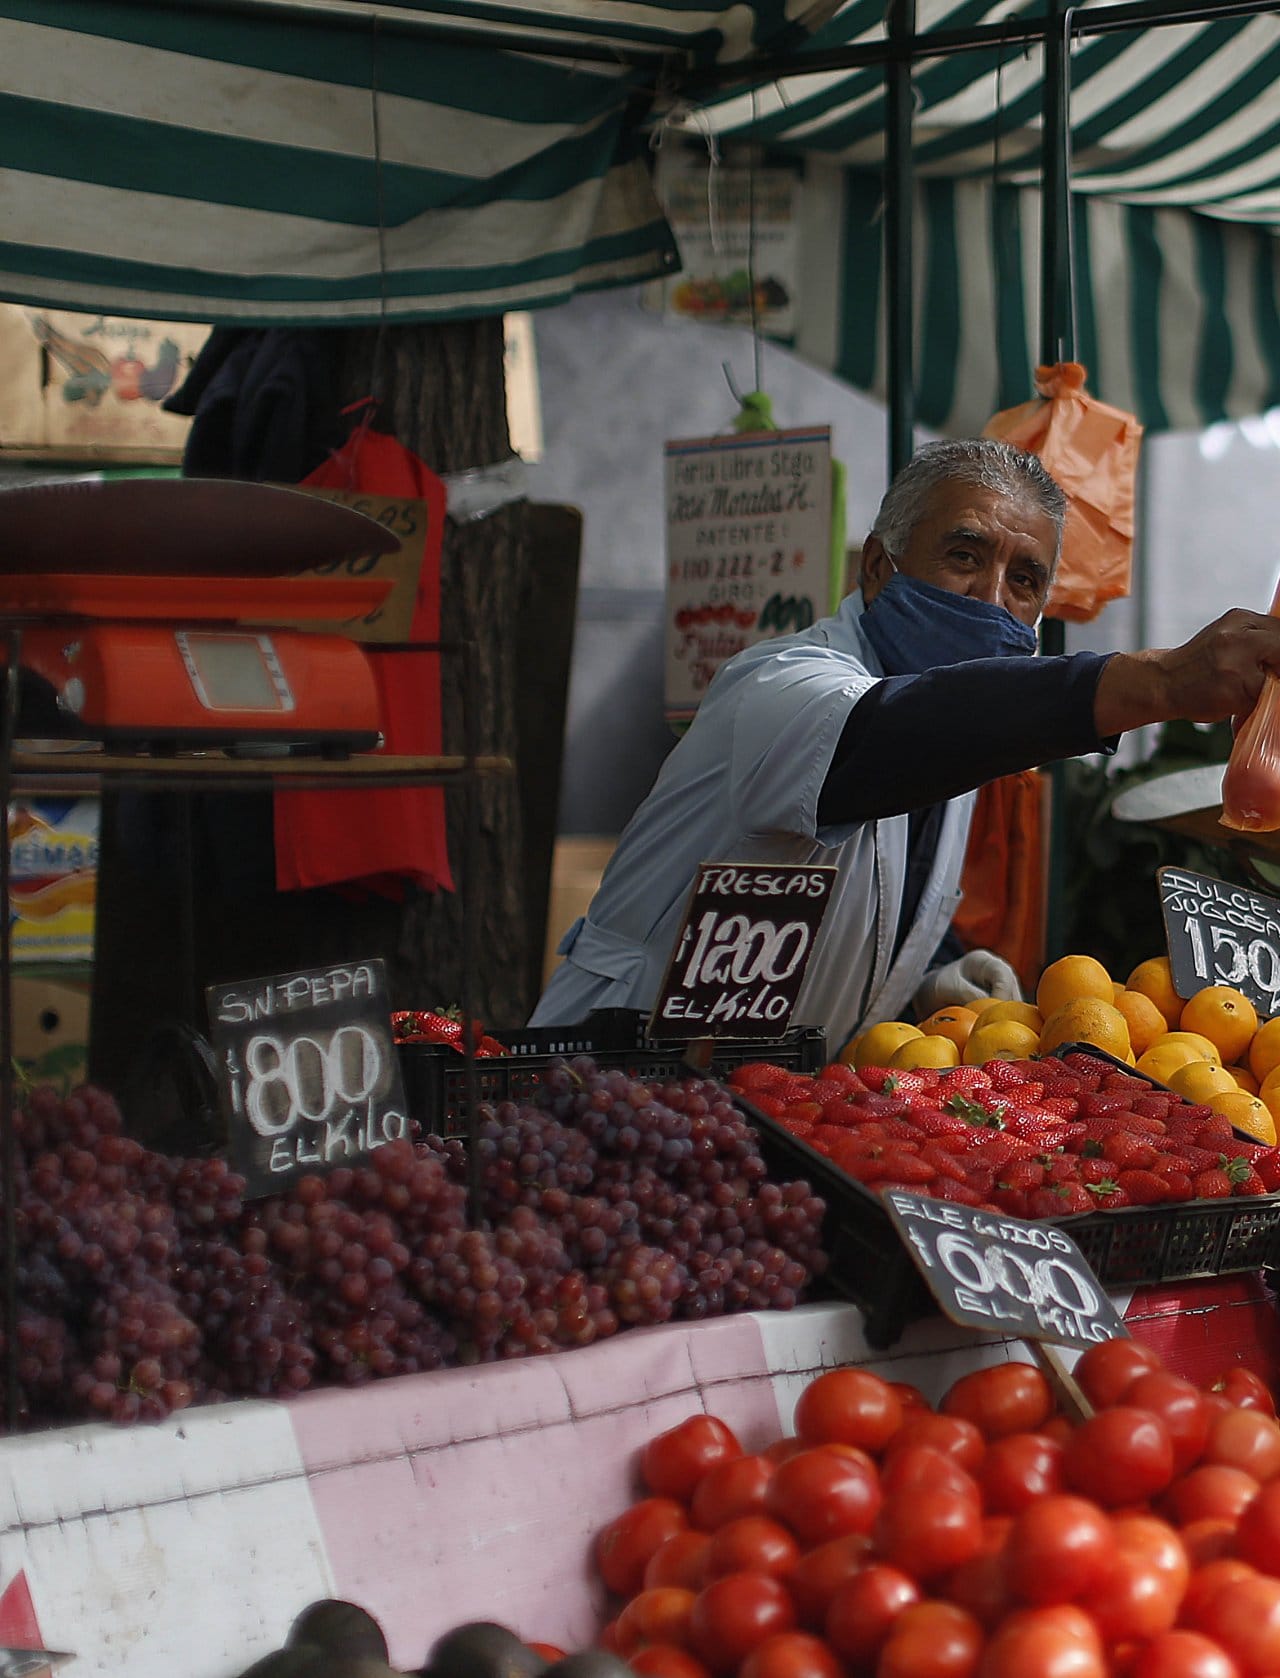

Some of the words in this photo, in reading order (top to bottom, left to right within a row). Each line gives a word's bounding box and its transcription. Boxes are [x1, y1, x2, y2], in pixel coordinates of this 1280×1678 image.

[697, 869, 826, 897] FRESCAS
[1162, 873, 1270, 919] DULCE
[276, 966, 373, 1008] PEPA
